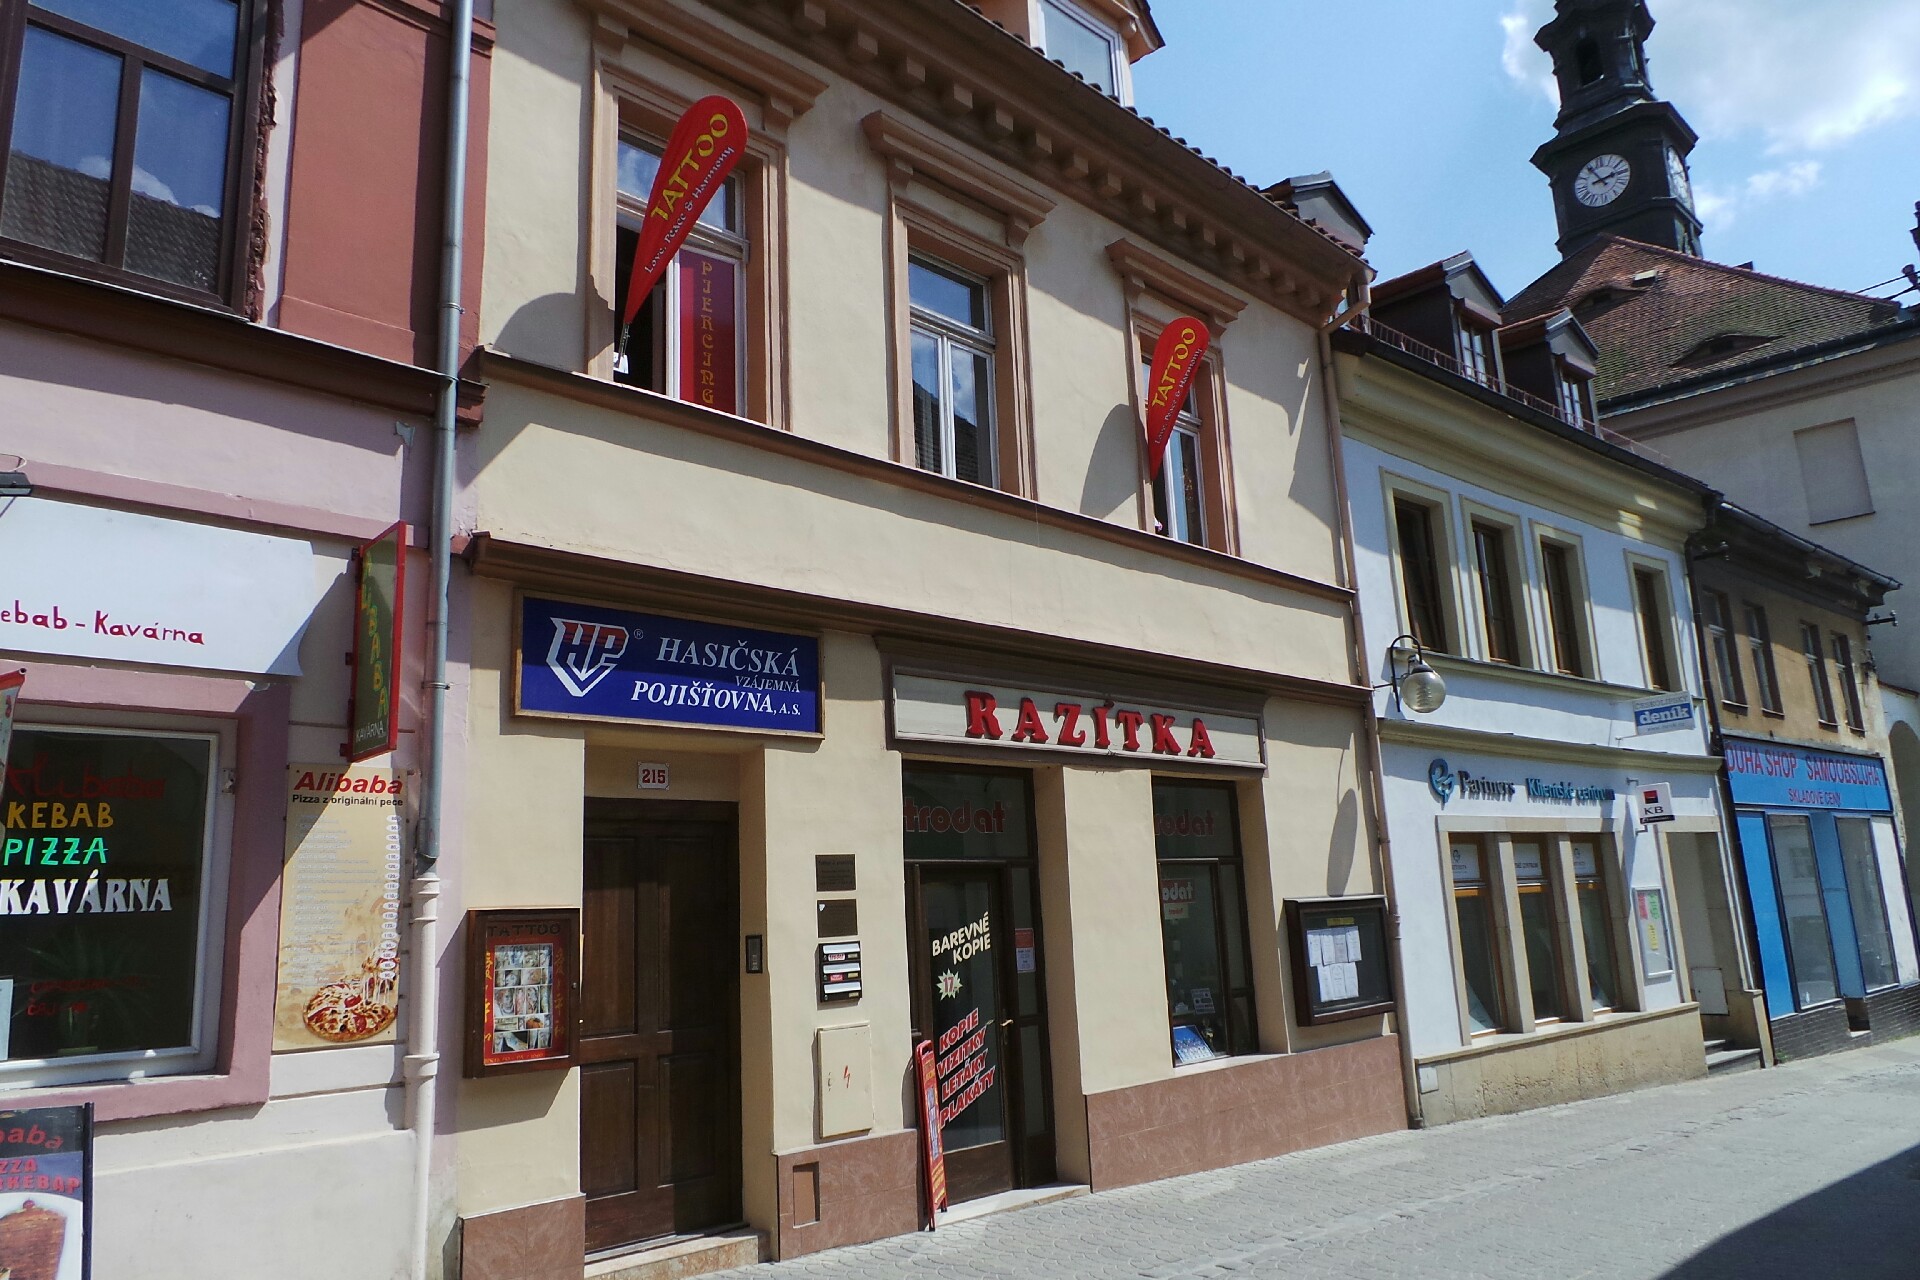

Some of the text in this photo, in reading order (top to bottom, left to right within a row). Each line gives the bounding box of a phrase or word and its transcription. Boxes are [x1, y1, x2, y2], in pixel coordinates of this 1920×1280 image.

[651, 113, 728, 221] TATTOO
[684, 200, 694, 212] &
[701, 261, 714, 404] PIERCING
[1152, 327, 1196, 407] TATTOO
[94, 610, 205, 645] Kavárna
[656, 636, 800, 677] HASIČSKÁ
[631, 680, 777, 715] POJIŠŤOVNA,
[735, 674, 800, 693] VZÁJEMNÁ
[963, 689, 1216, 759] RAZÍTKA
[642, 769, 666, 784] 215
[1765, 749, 1797, 779] SHOP
[293, 771, 403, 795] Alibaba
[1457, 769, 1516, 795] Partners
[6, 802, 114, 829] KEBAB
[292, 794, 320, 804] Pizza
[331, 795, 377, 806] originální
[380, 798, 403, 807] pece
[904, 796, 1006, 834] trodat
[1644, 806, 1664, 815] KB
[1155, 808, 1215, 837] rodat
[3, 837, 109, 866] PIZZA
[0, 869, 172, 915] KAVÁRNA
[1162, 881, 1193, 901] odat
[486, 923, 561, 936] TATTOO
[932, 911, 990, 957] BAREVNÉ
[952, 933, 991, 965] KOPIE
[939, 1007, 979, 1055] KOPIE
[936, 1024, 987, 1079] VIZITKY
[942, 1048, 988, 1103] LETÁKY
[939, 1065, 996, 1130] PLAKÁTY
[0, 1175, 81, 1196] KEBAP
